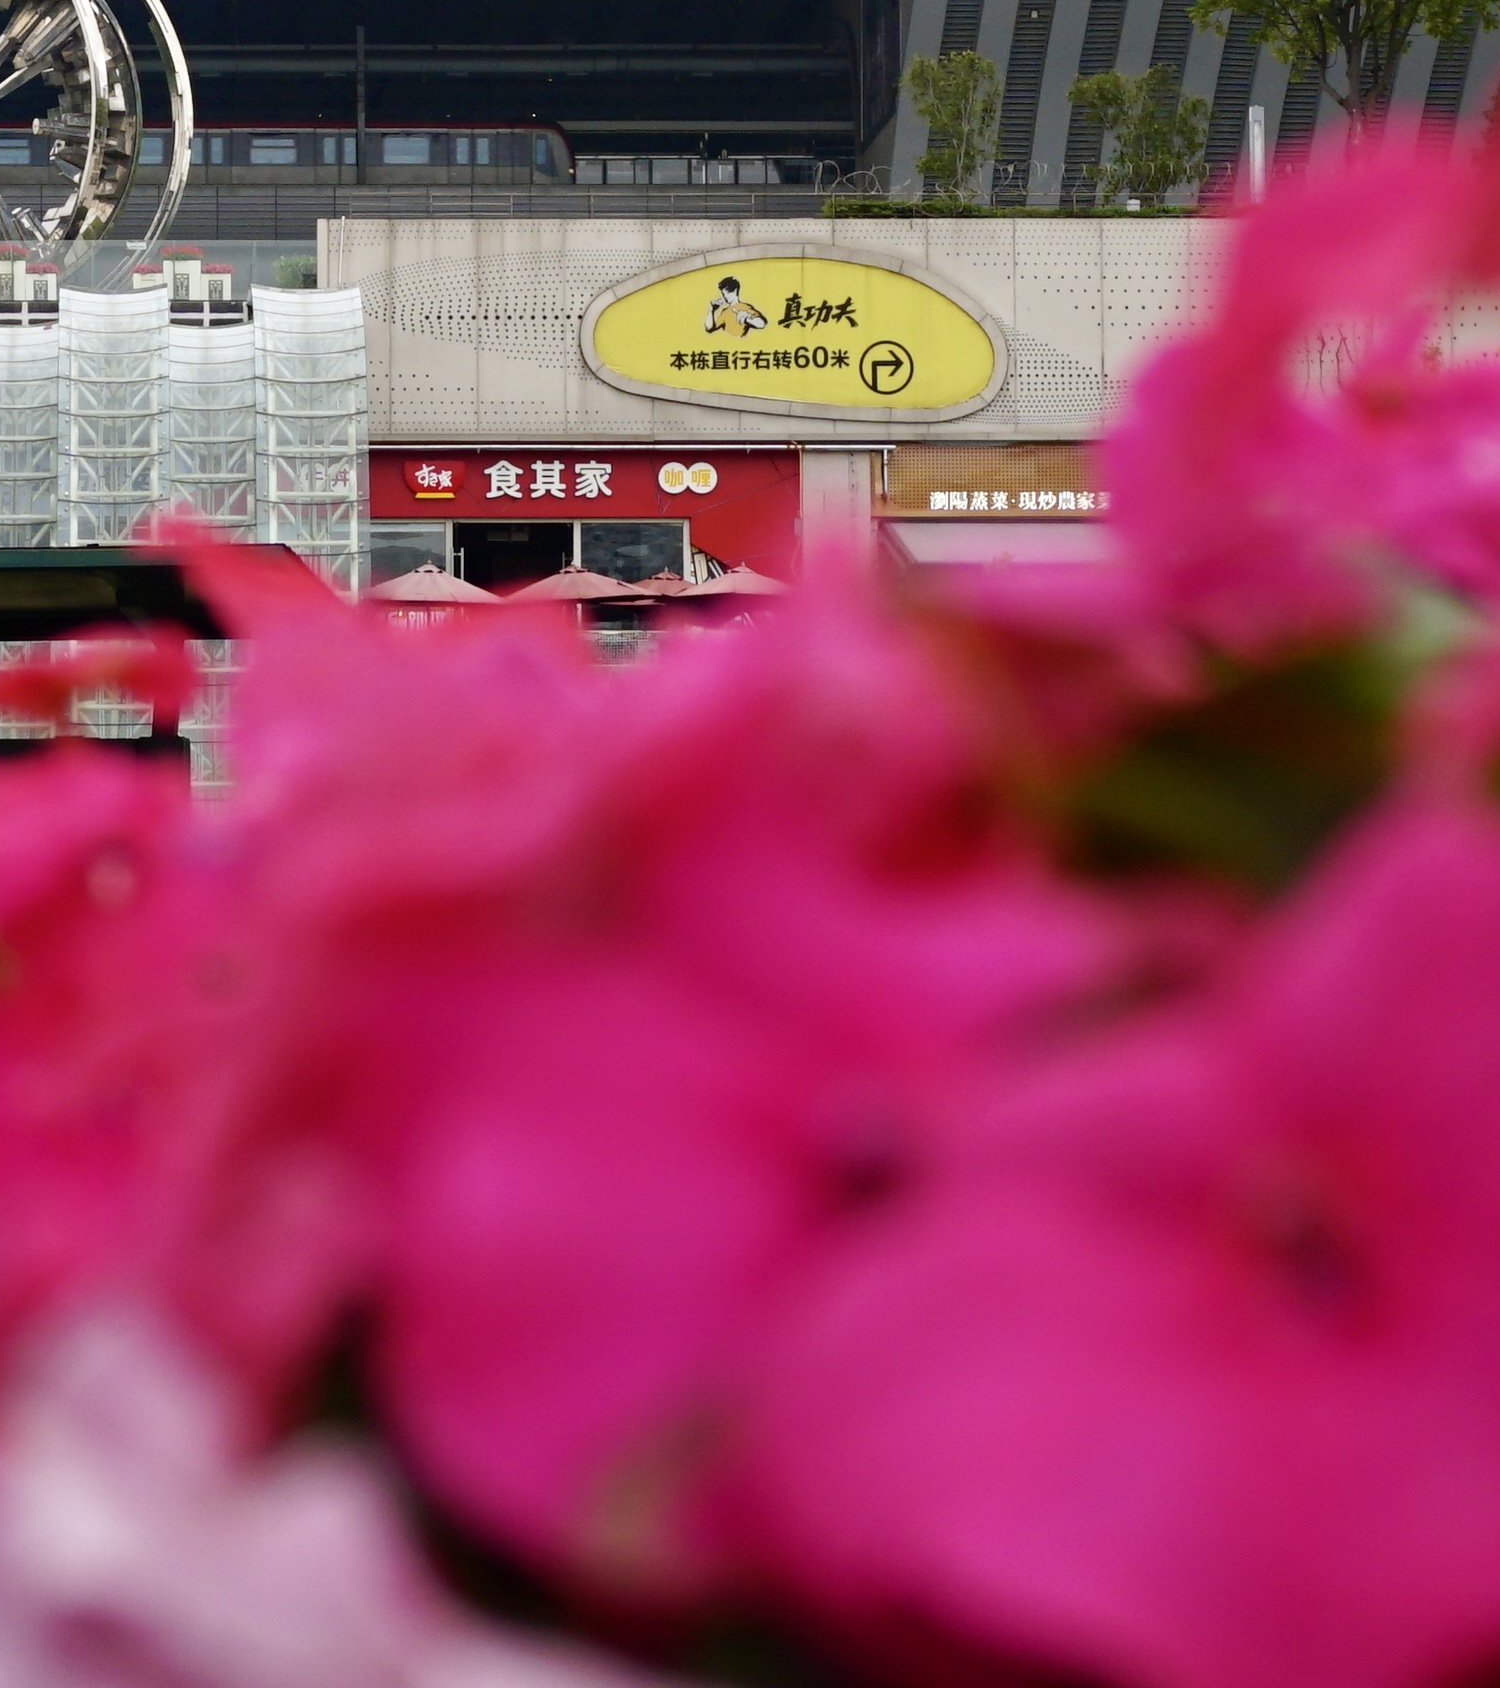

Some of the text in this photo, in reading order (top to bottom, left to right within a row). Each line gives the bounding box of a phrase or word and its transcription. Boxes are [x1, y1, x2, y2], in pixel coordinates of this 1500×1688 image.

[777, 292, 859, 330] 真功夫
[669, 345, 850, 371] 本栋直行右转60米
[483, 459, 613, 499] 食其家
[664, 467, 712, 487] 咖喱
